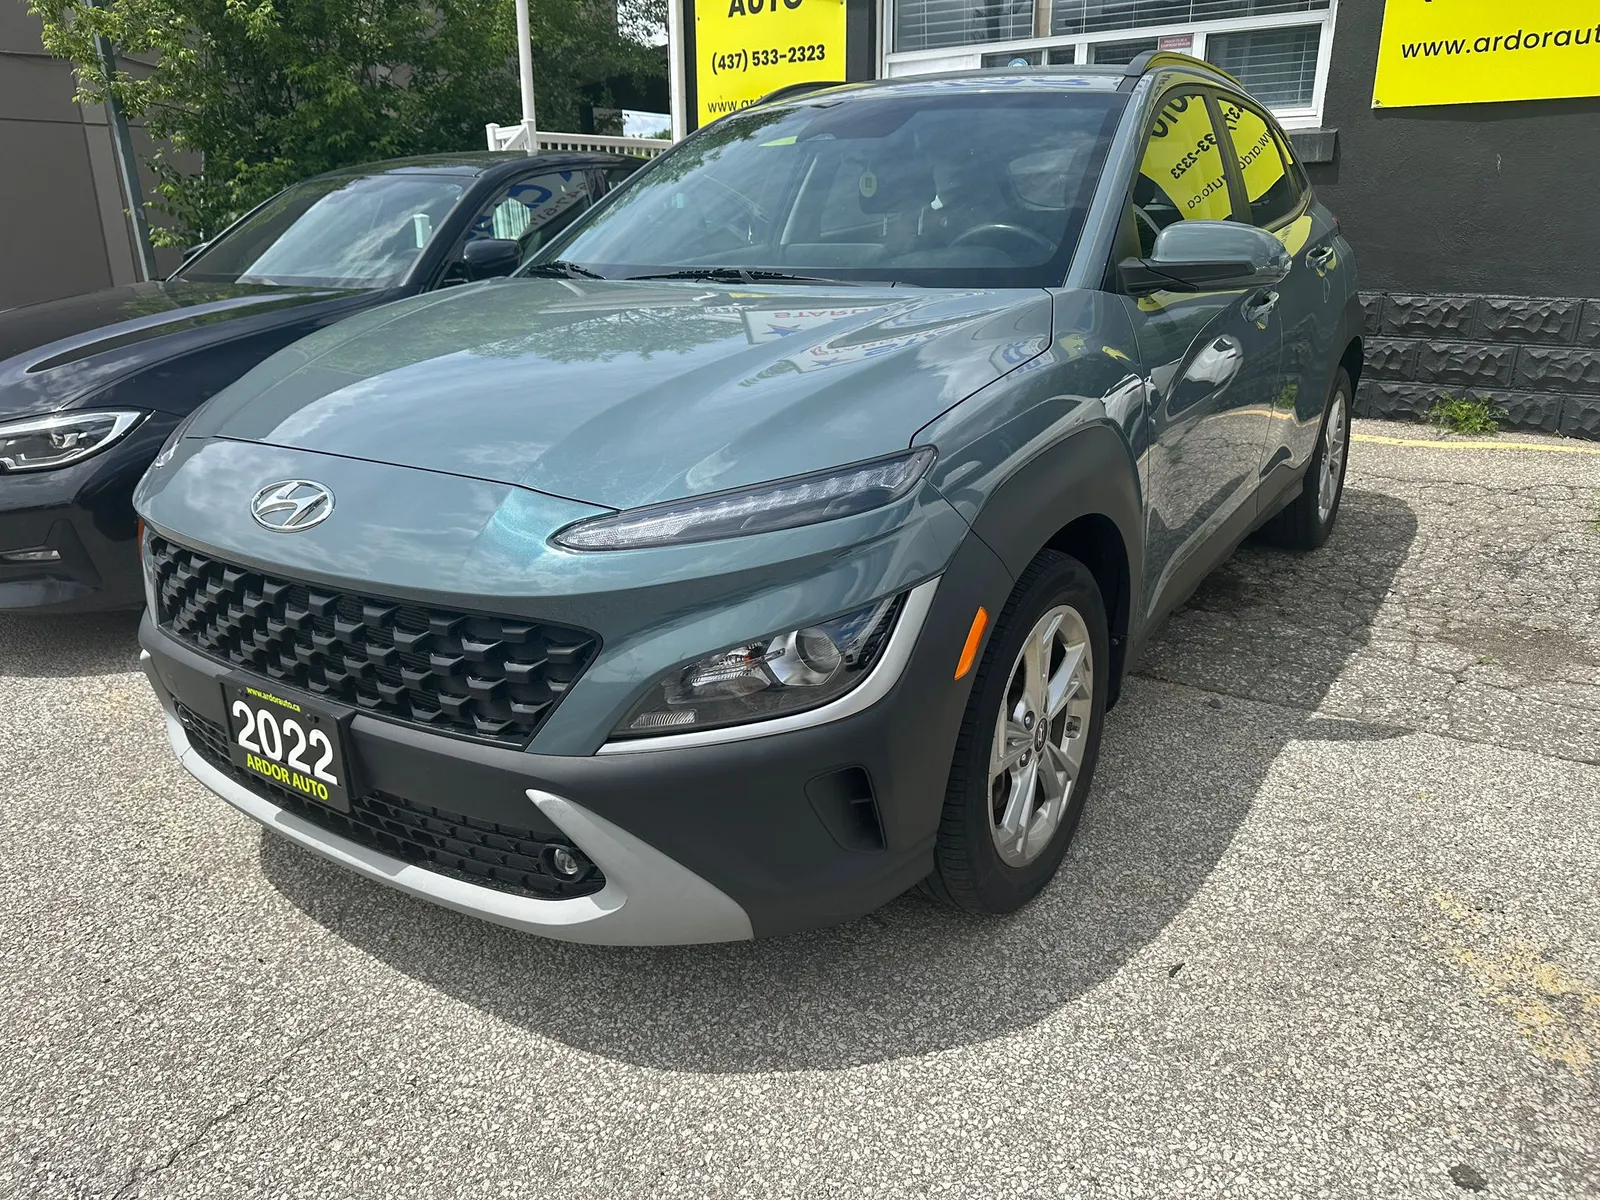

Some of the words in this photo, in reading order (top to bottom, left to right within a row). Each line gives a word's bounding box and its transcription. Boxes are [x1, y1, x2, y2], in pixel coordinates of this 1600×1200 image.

[711, 48, 749, 75] (437)
[752, 44, 826, 67] 533-2323
[245, 686, 302, 713] www.ardorauto.ca
[232, 699, 339, 786] 2022
[246, 752, 291, 786] ARDOR
[292, 772, 330, 801] AUTO
